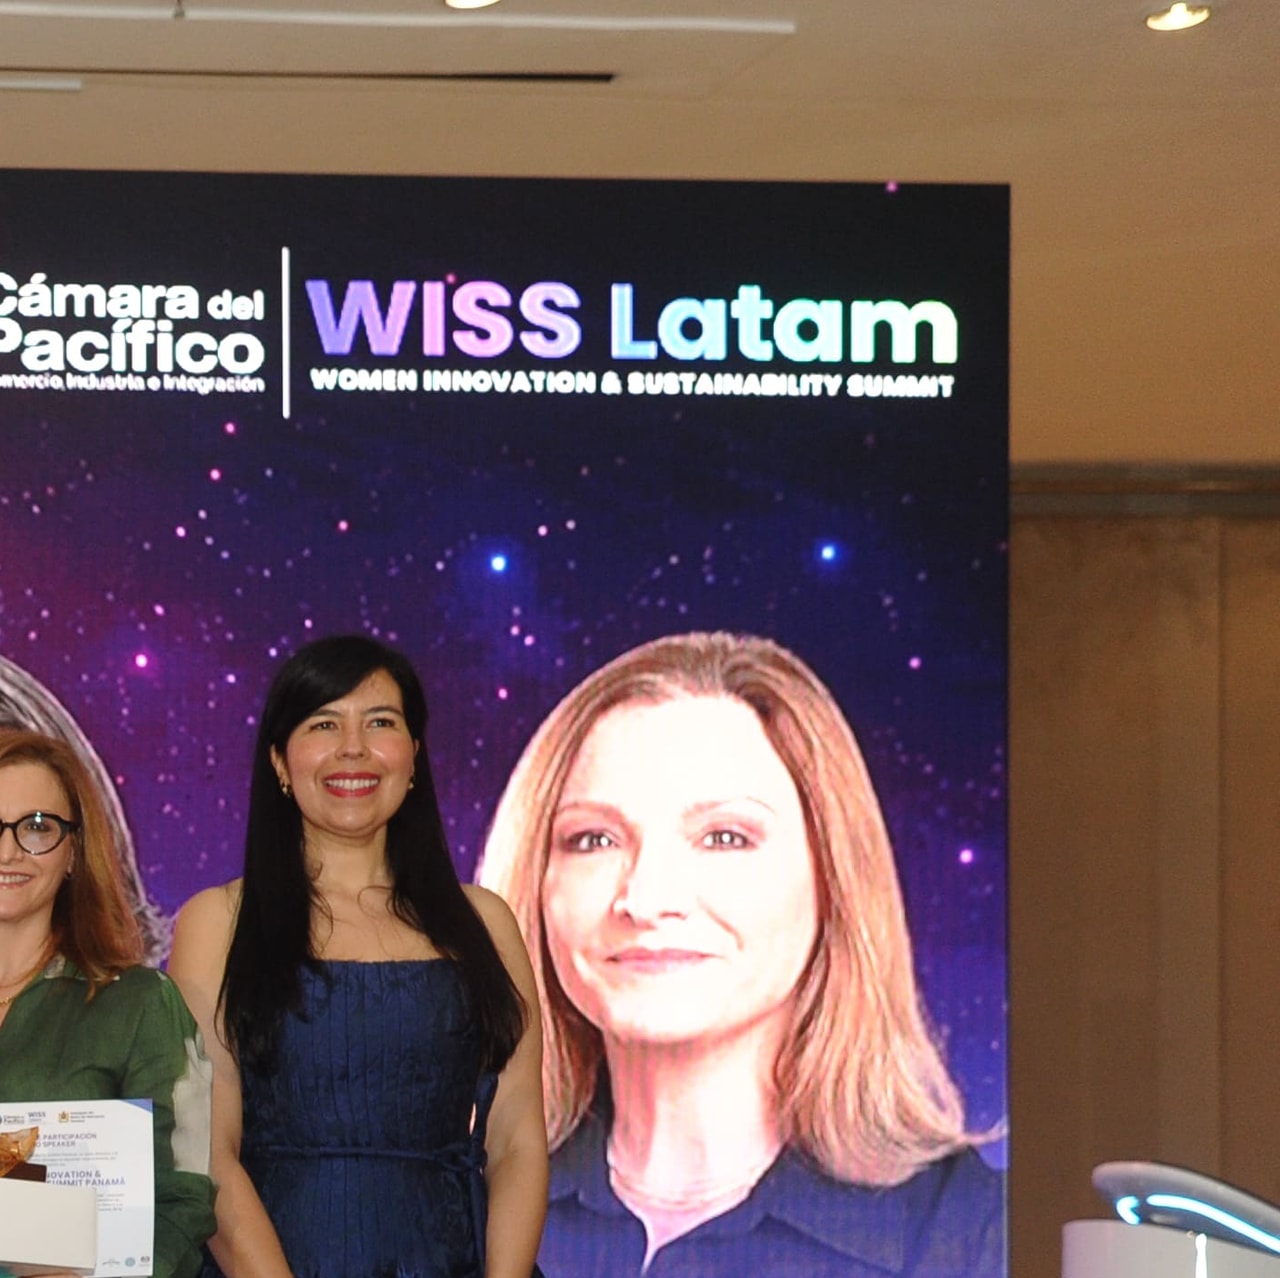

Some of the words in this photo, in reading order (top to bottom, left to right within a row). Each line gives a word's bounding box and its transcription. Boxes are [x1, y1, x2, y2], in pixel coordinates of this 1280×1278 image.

[206, 289, 265, 320] del
[305, 279, 582, 358] WISS
[610, 282, 958, 364] Latam
[66, 373, 146, 392] Industria
[147, 376, 161, 391] e
[163, 374, 266, 395] Integración
[310, 368, 418, 392] WOMEN
[422, 369, 597, 394] INNOVATION
[600, 370, 622, 395] &
[627, 371, 843, 397] SUSTAINABILITY
[846, 373, 955, 398] SUMMIT
